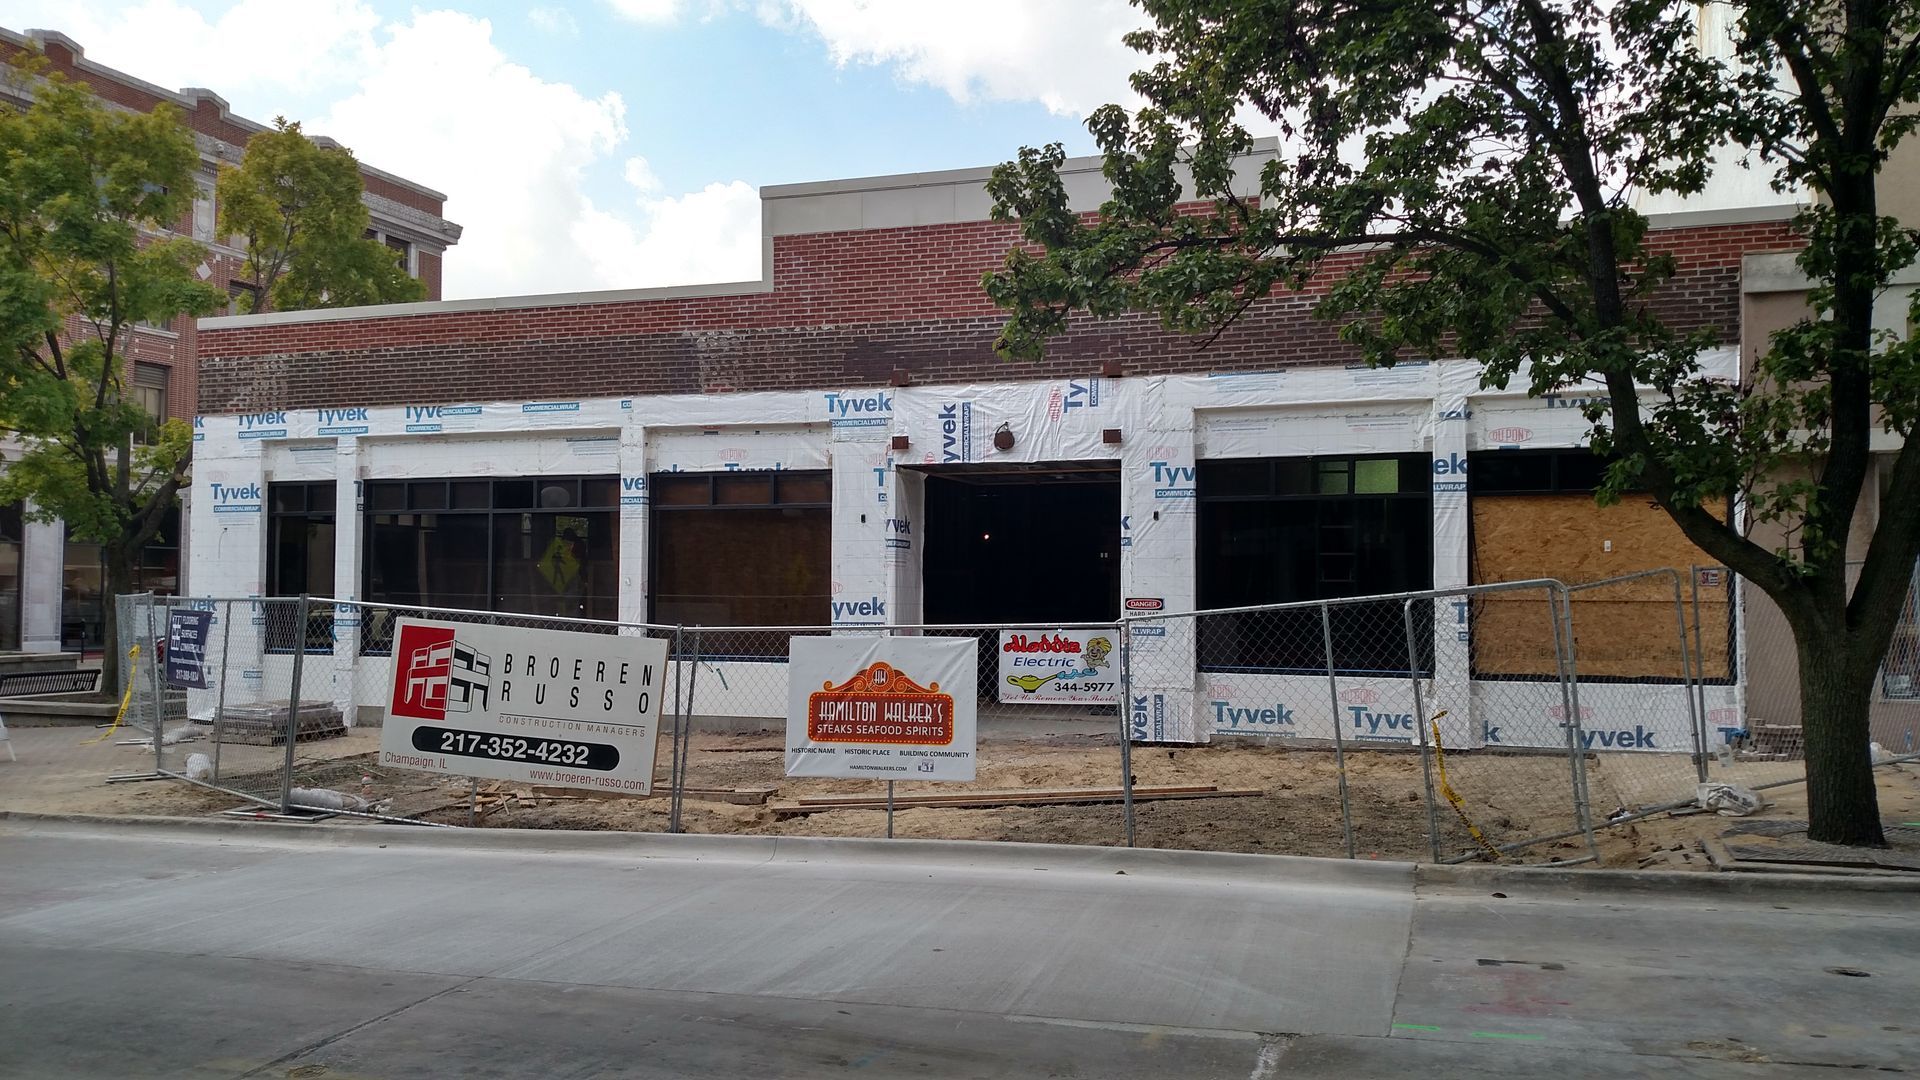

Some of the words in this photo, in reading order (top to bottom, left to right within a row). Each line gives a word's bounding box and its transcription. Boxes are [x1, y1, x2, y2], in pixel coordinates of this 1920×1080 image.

[524, 404, 577, 412] COMMERCIALWRAP
[824, 393, 892, 417] Tyvek
[211, 483, 261, 504] Tyvek
[504, 653, 652, 687] BROEREN
[1013, 656, 1075, 667] Electric
[501, 681, 649, 714] RUSSO
[1054, 682, 1115, 692] 344-5977
[819, 701, 877, 722] HAMILTON
[884, 702, 943, 724] WALKER'S
[1211, 701, 1295, 728] Tyvek
[499, 715, 581, 731] CONSTRUCTION
[586, 724, 646, 738] MANAGERS
[817, 723, 853, 734] STEAKS
[856, 724, 902, 735] SEAFOOD
[905, 725, 944, 737] SPIRITS
[440, 731, 589, 765] 217-352-4232
[791, 747, 817, 755] HISTORIC
[818, 747, 836, 755] NAME
[844, 748, 871, 757] HISTORIC
[872, 749, 891, 757] PLACE
[900, 750, 928, 758] BUILDING
[929, 750, 970, 759] COMMUNITY
[439, 757, 447, 769] IL
[849, 764, 908, 772] HAMILTONWALKERS.COM
